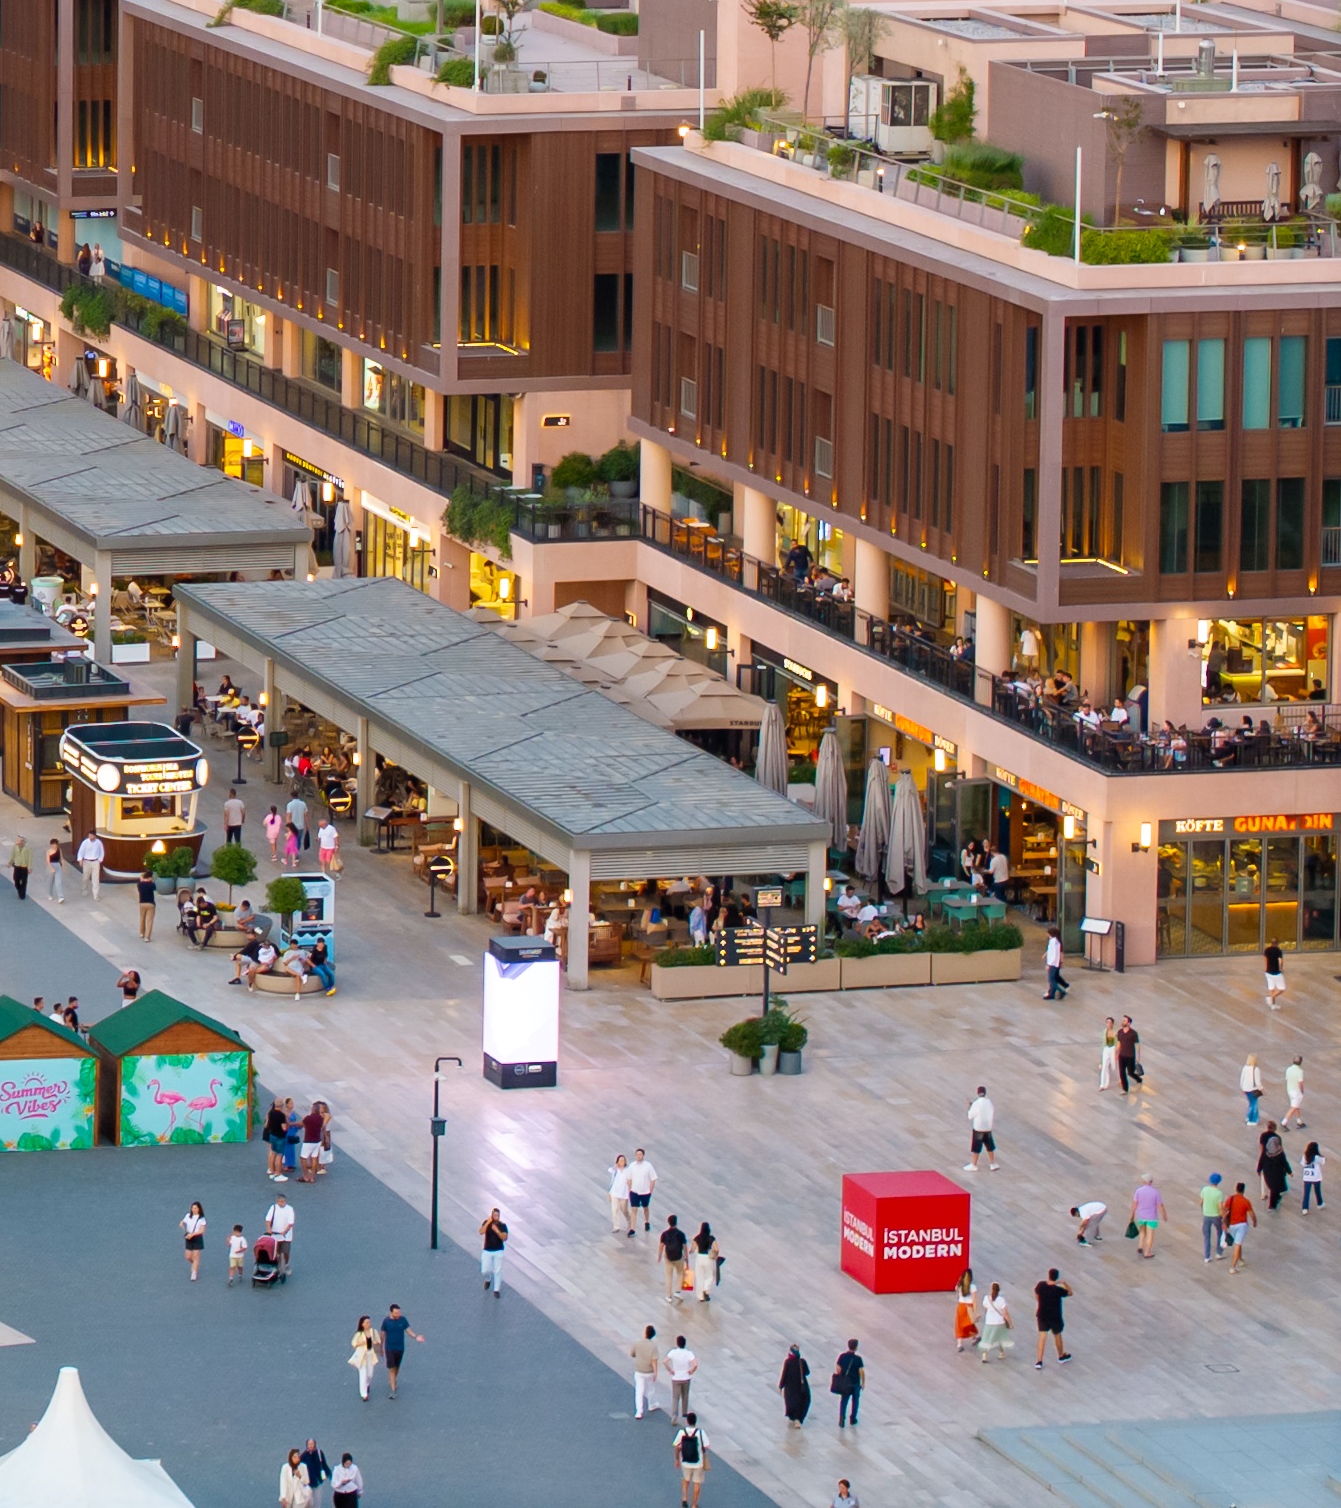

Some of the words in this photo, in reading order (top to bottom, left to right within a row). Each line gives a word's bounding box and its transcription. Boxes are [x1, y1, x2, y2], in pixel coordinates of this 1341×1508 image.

[126, 782, 158, 794] TICKET
[159, 780, 192, 792] CENTER
[1175, 818, 1224, 833] KÖFTE
[0, 1080, 67, 1102] Summer
[4, 1099, 62, 1116] Vibes
[843, 1205, 875, 1242] İSTANBUL
[843, 1225, 875, 1258] MODERN
[883, 1227, 964, 1244] İSTANBUL
[883, 1243, 963, 1260] MODERN
